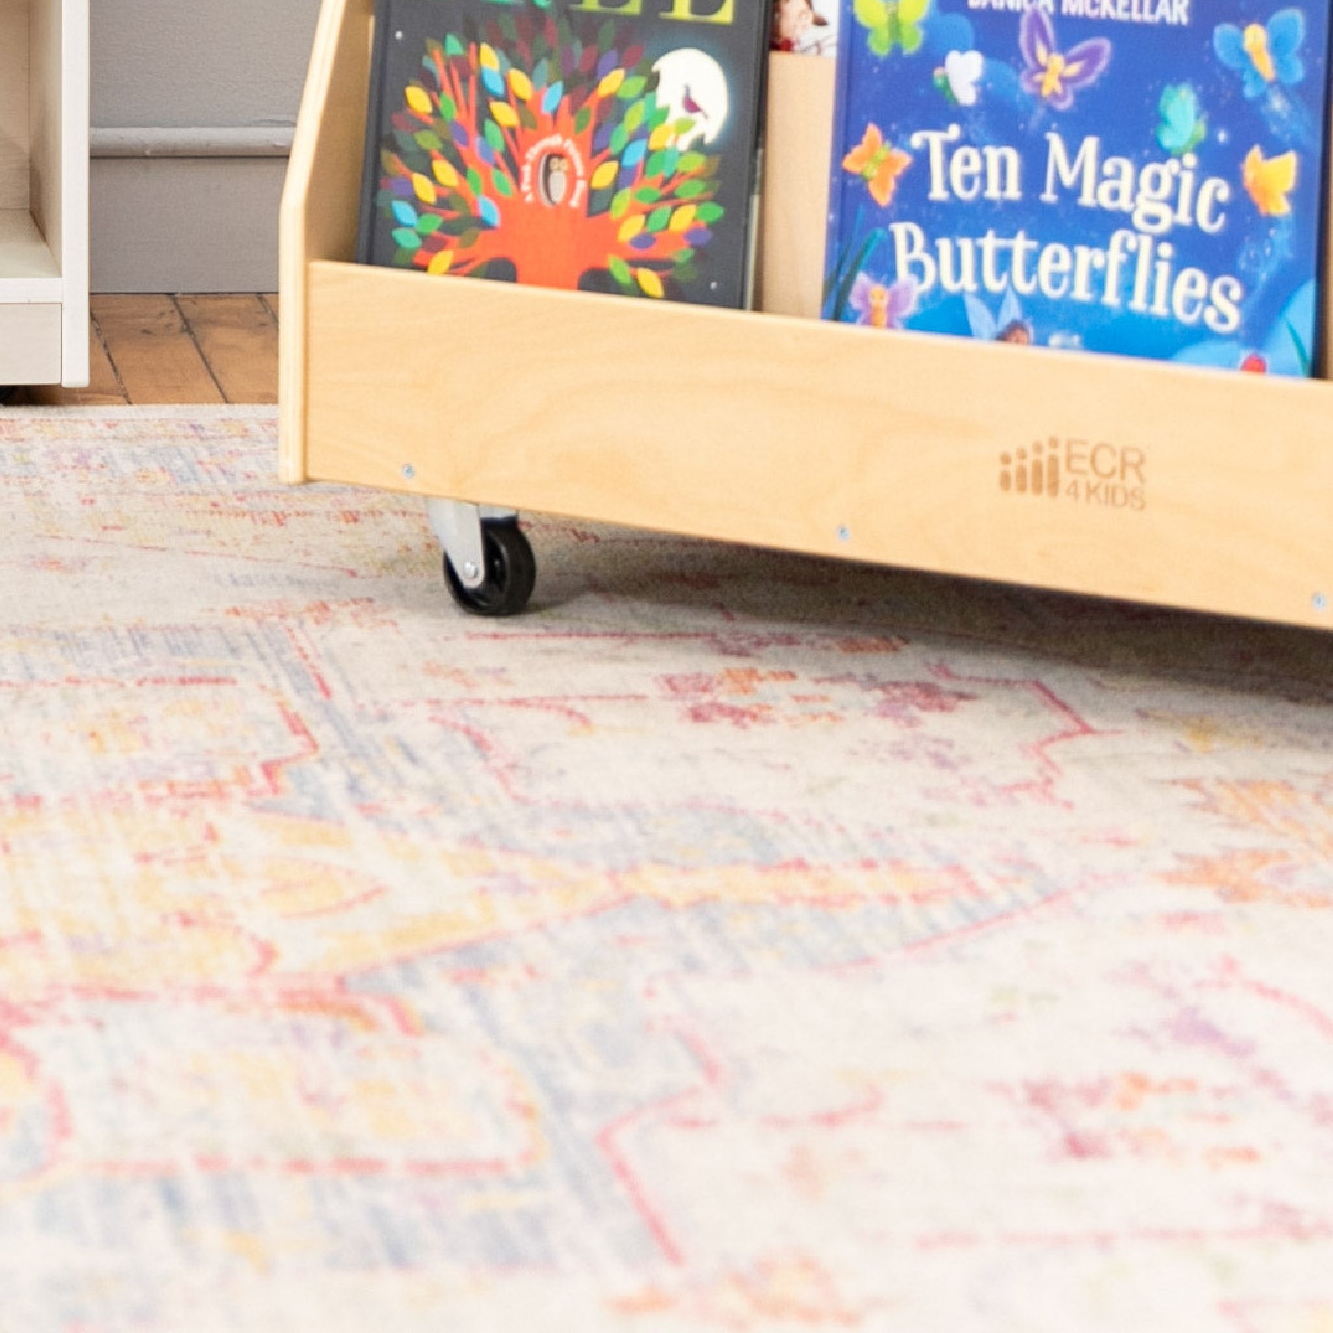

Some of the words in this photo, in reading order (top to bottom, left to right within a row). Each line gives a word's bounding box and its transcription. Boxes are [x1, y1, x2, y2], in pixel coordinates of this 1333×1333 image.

[910, 122, 1023, 202] Ten
[1039, 131, 1231, 234] Magic
[887, 221, 1244, 334] Butterflies
[1064, 437, 1147, 484] ECR
